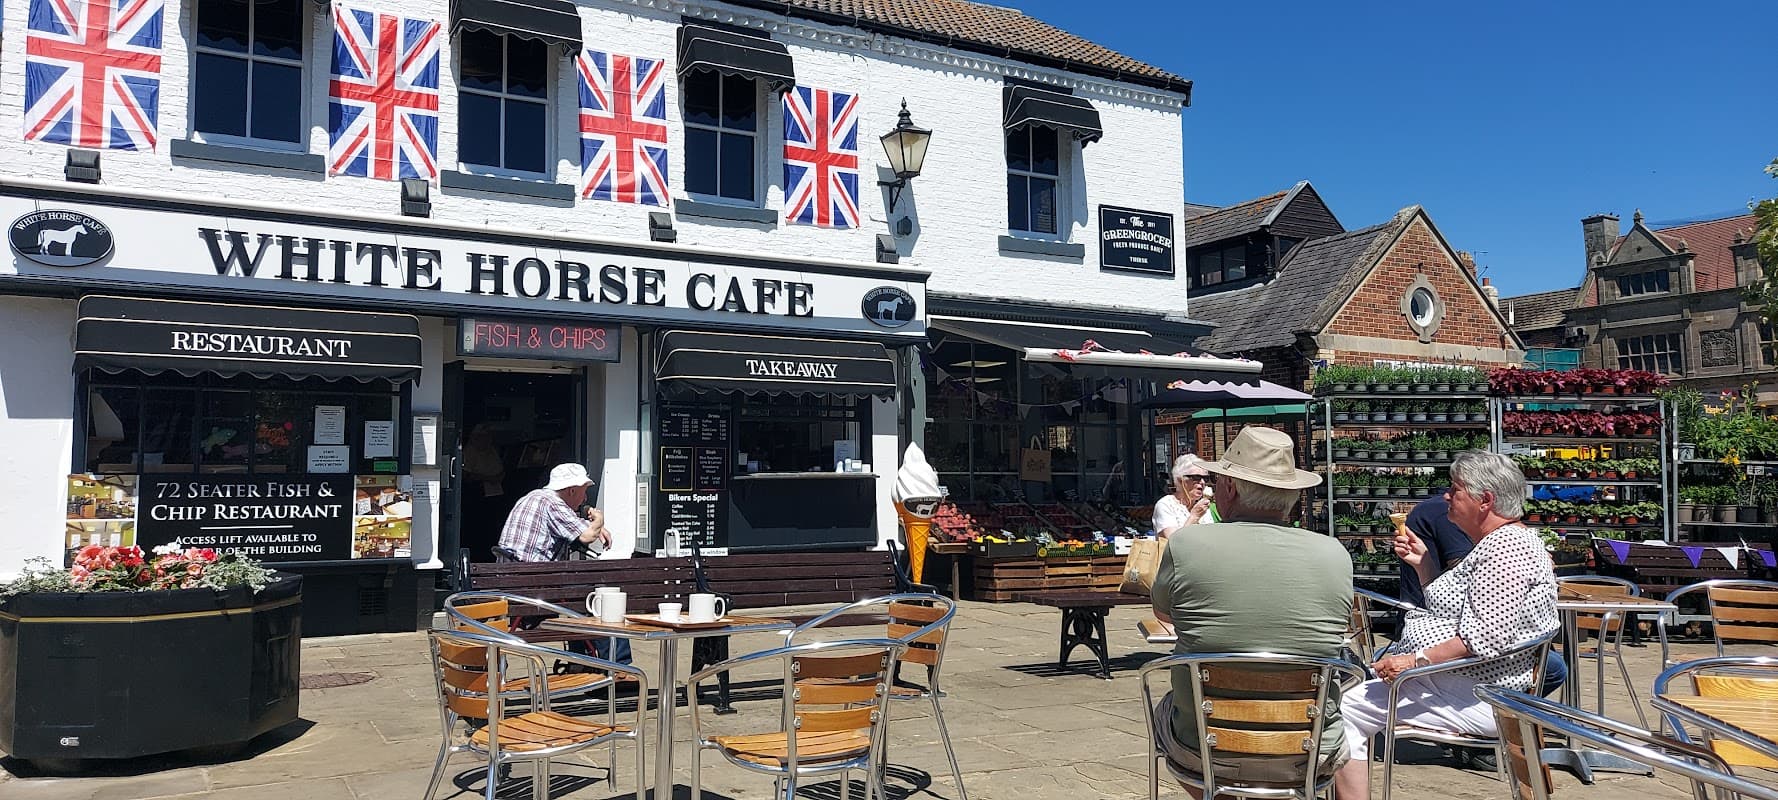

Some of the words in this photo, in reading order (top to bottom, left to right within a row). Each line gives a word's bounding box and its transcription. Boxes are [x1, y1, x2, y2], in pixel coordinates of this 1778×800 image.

[16, 212, 47, 231] WHITE
[48, 211, 82, 223] HORSE
[1130, 216, 1144, 227] The
[1103, 229, 1172, 249] GREENGROCER
[198, 227, 442, 290] WHITE
[465, 252, 666, 307] HORSE
[686, 272, 814, 318] CAFE
[170, 331, 352, 358] RESTAURANT
[475, 324, 520, 348] FISH
[527, 327, 543, 349] &
[550, 326, 606, 351] CHIPS
[745, 359, 838, 379] TAKEAWAY
[156, 482, 181, 499] 72
[187, 482, 261, 498] SEATER
[266, 481, 310, 498] FISH
[317, 481, 336, 498] &
[692, 494, 719, 503] Special
[150, 504, 207, 521] CHIP
[213, 503, 342, 520] RESTAURANT
[175, 535, 216, 545] ACCESS
[219, 535, 244, 545] LIFT
[244, 534, 305, 544] AVAILABLE
[305, 533, 318, 542] TO
[268, 544, 322, 554] BUILDING
